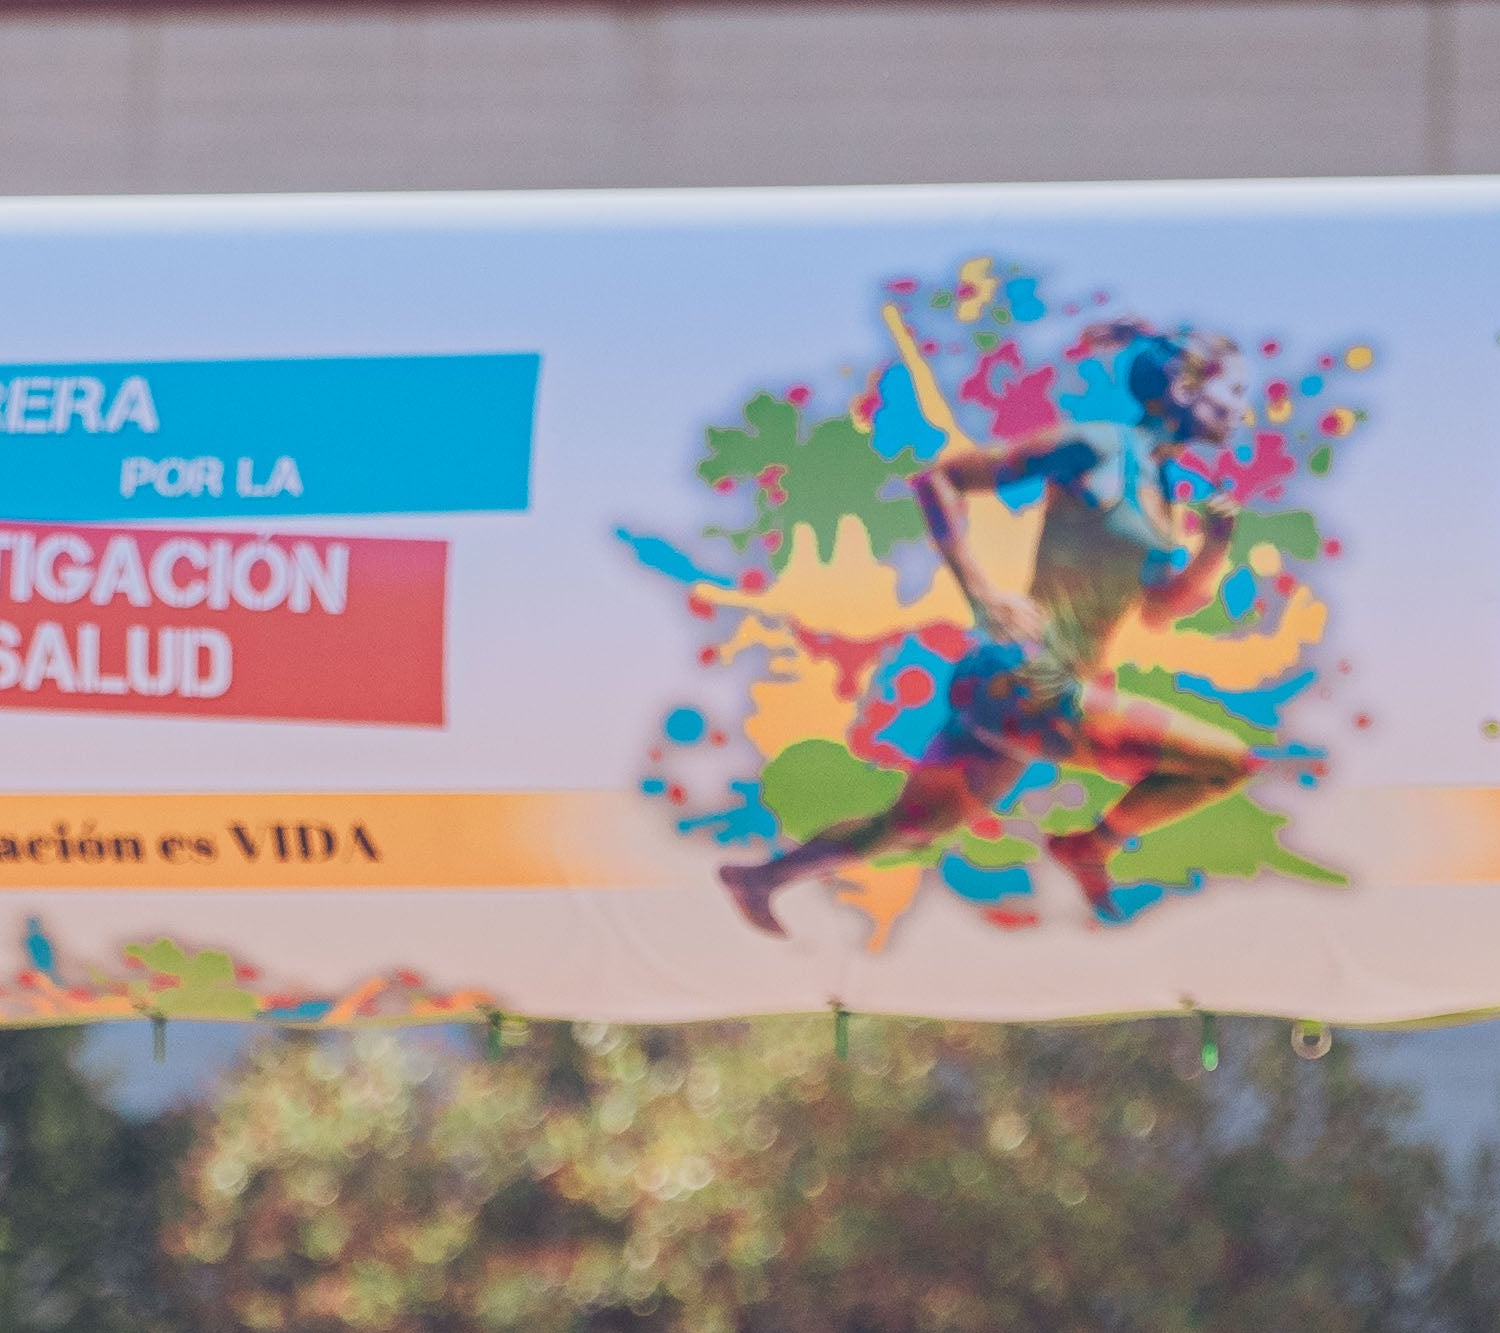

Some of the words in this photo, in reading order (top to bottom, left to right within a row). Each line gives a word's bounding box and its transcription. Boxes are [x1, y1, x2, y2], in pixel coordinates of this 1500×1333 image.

[120, 455, 224, 499] POR
[235, 455, 303, 499] LA
[156, 829, 219, 865] es
[228, 819, 384, 865] VIDA
